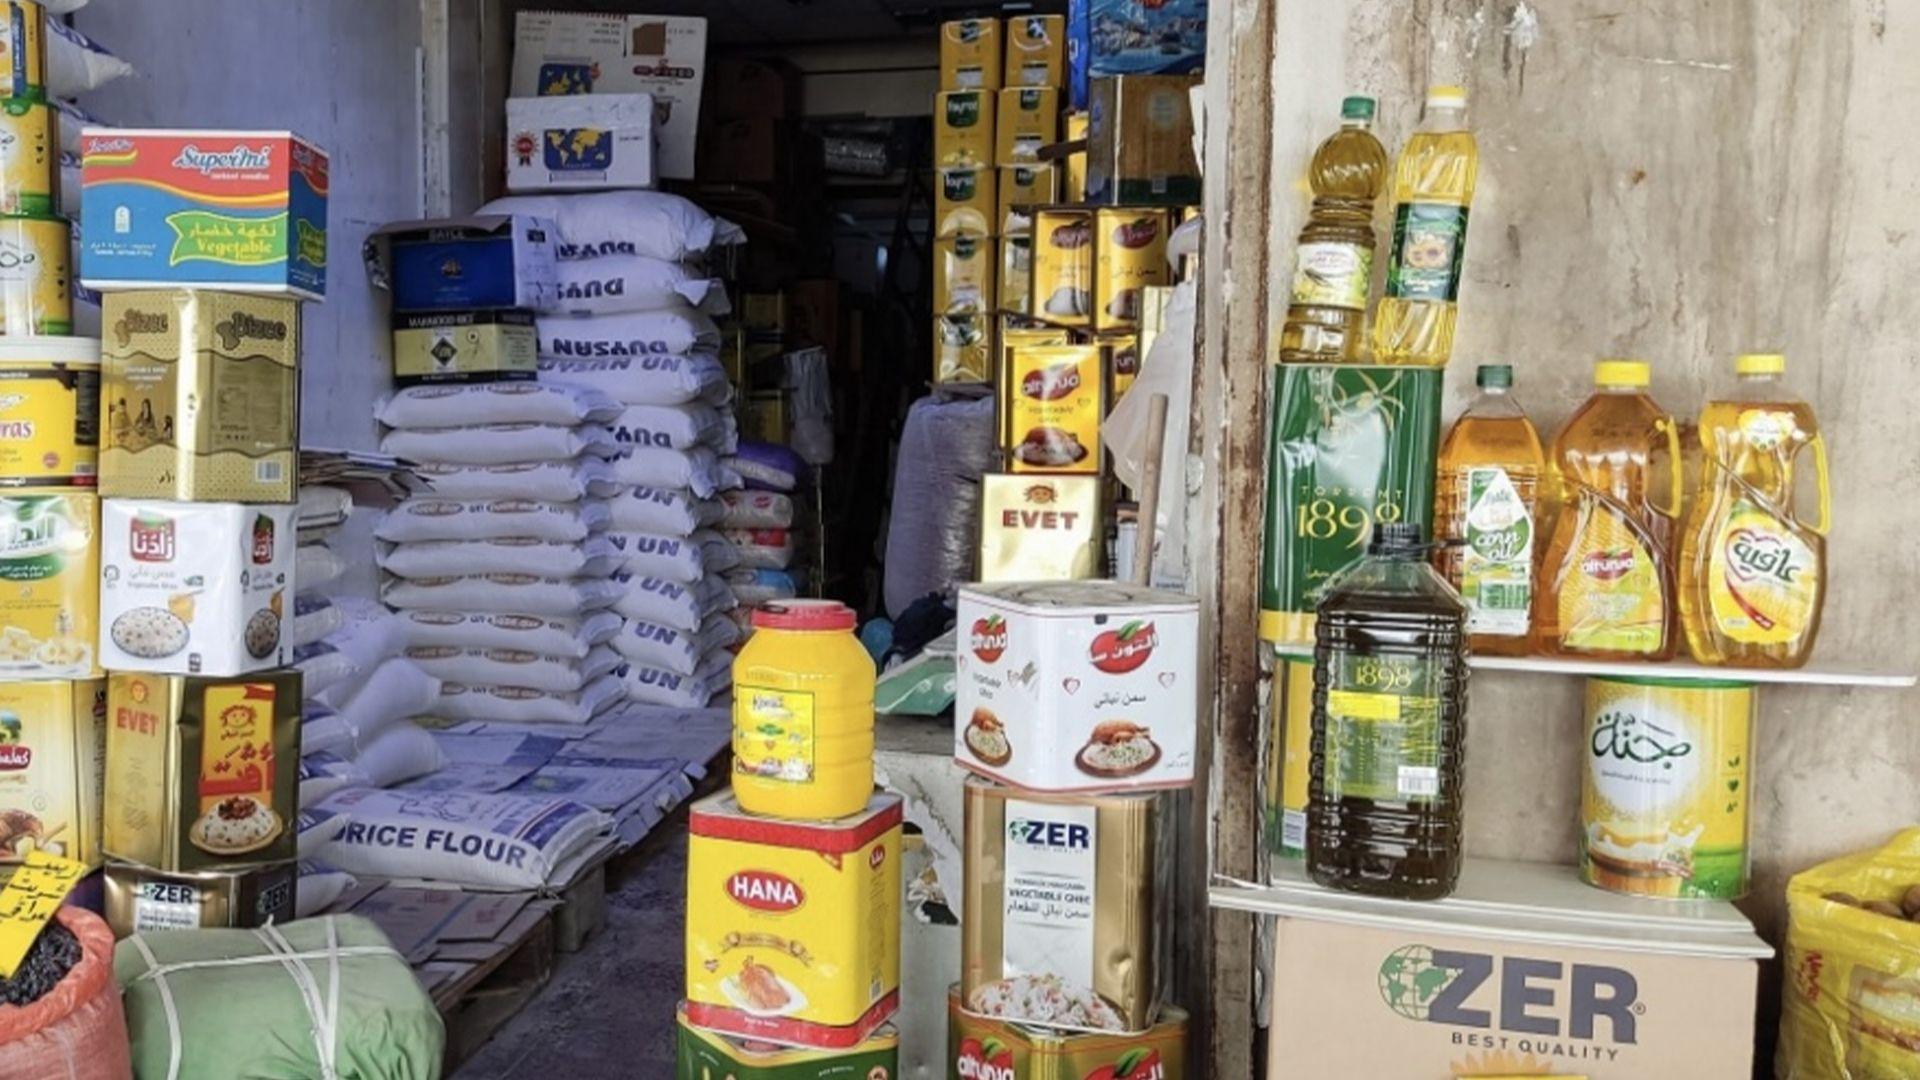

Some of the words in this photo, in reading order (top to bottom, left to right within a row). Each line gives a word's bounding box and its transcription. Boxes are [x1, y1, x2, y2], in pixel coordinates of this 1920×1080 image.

[197, 236, 273, 257] Vegetable
[552, 338, 669, 357] DUYSAN
[1002, 509, 1079, 530] EVET
[638, 536, 681, 557] UN
[1475, 530, 1521, 546] corn
[1733, 536, 1800, 583] عافية
[640, 577, 685, 600] UN
[635, 621, 678, 645] UN
[638, 666, 682, 691] UN
[1356, 663, 1412, 692] 1898
[116, 708, 160, 737] EVET
[348, 822, 417, 849] RICE
[424, 829, 527, 869] FLOUR
[1026, 821, 1090, 849] ZER
[154, 884, 194, 904] ZER
[264, 883, 288, 911] ZER
[734, 875, 799, 906] HANA
[1428, 948, 1639, 1045] ZER
[1452, 1031, 1508, 1050] BEST
[1518, 1040, 1619, 1061] QUALITY
